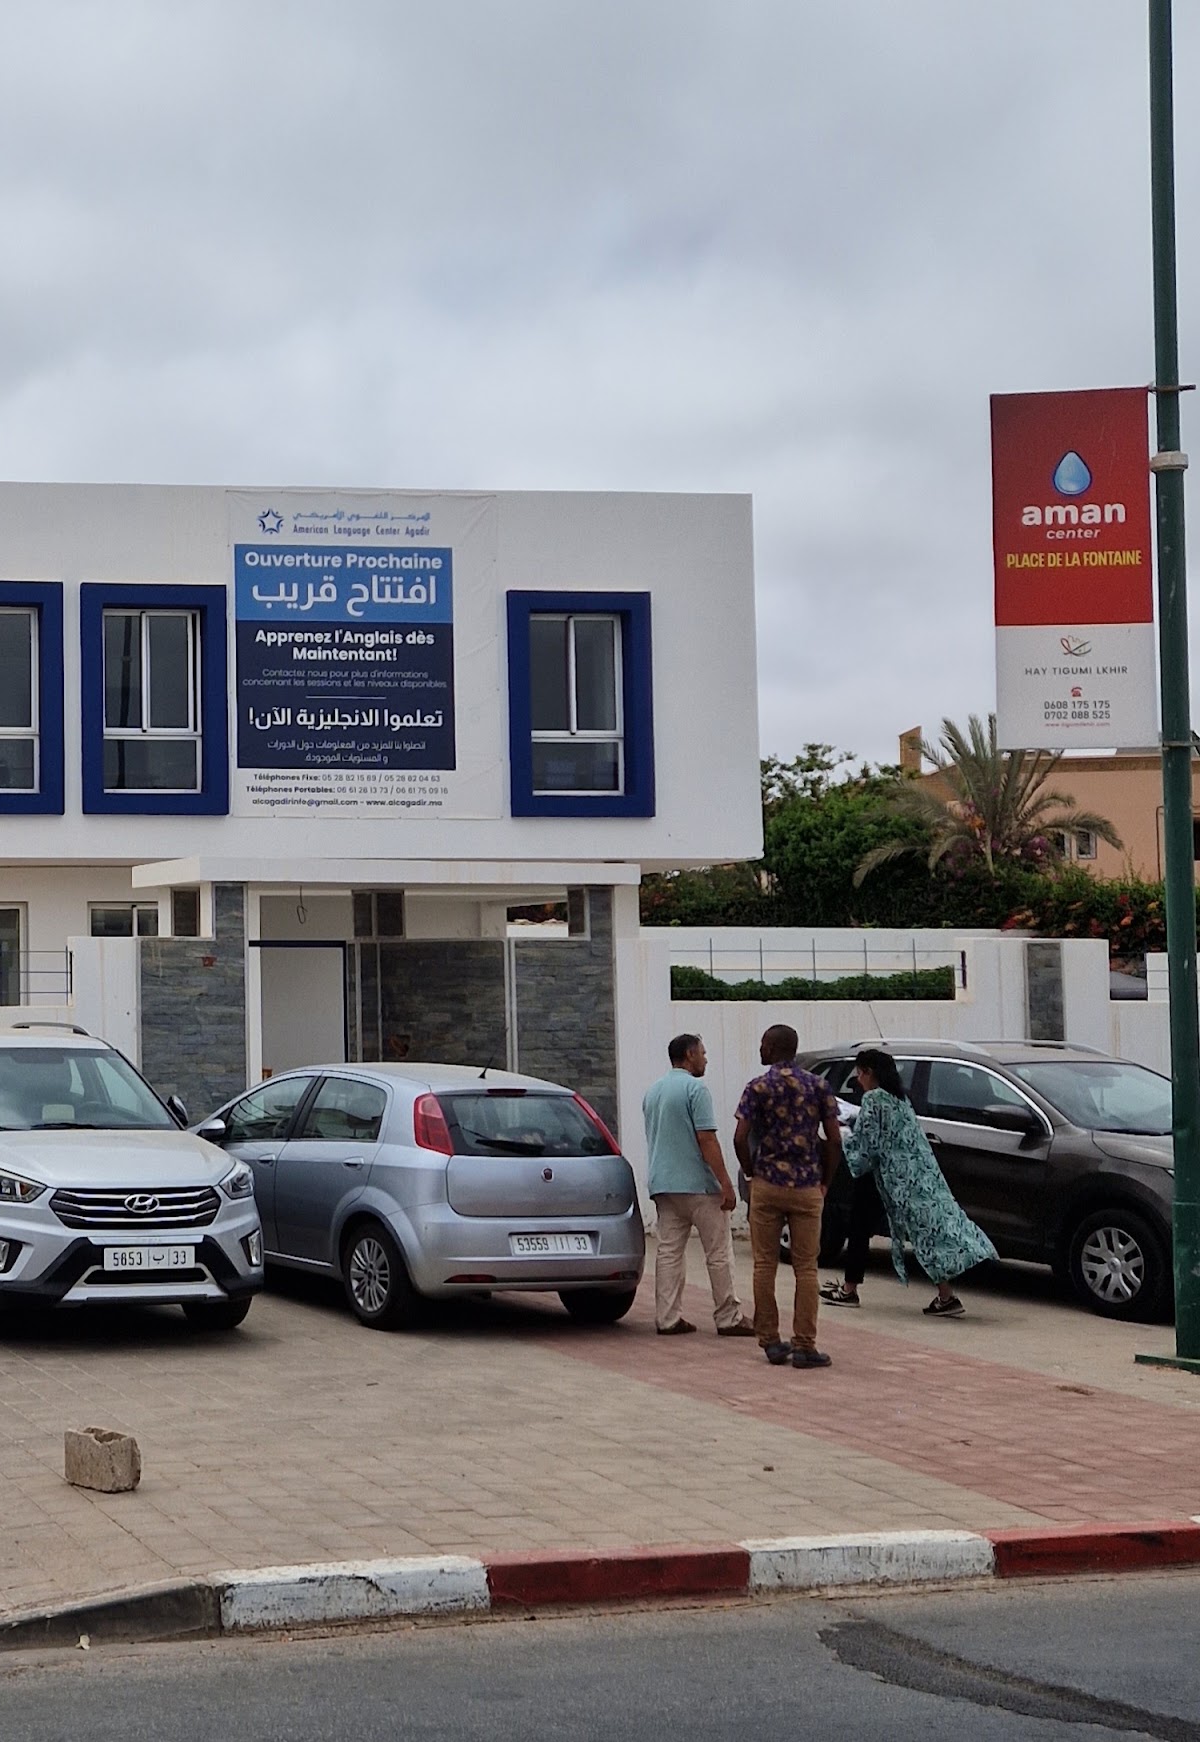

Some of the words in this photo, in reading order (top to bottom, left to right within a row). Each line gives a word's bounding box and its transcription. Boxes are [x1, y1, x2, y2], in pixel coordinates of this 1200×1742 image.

[1021, 502, 1126, 526] aman
[293, 524, 329, 535] American
[333, 525, 371, 537] Language
[375, 525, 400, 536] Center
[405, 526, 430, 538] Agadir
[1046, 528, 1101, 539] center
[244, 551, 342, 568] Ouverture
[346, 552, 443, 570] Prochaine
[1006, 552, 1045, 568] PLACE
[1047, 552, 1062, 567] DE
[1065, 551, 1080, 566] LA
[1083, 549, 1142, 566] FONTAINE
[252, 575, 337, 611] قريب
[346, 574, 436, 617] افتتاح
[255, 629, 332, 647] Apprenez
[334, 629, 403, 648] l'Anglais
[405, 630, 435, 645] dès
[293, 647, 397, 662] Maintentant!
[262, 668, 305, 677] Contactez
[307, 670, 328, 678] nous
[330, 670, 349, 679] pour
[351, 669, 368, 680] plus
[370, 669, 428, 679] d'informations
[1025, 667, 1047, 675] HAY
[1052, 667, 1092, 675] TIGUMI
[1096, 666, 1128, 674] LKHIR
[242, 678, 291, 686] concernant
[293, 678, 305, 686] les
[307, 679, 342, 687] sessions
[354, 679, 365, 687] les
[367, 680, 399, 688] niveaux
[1044, 701, 1068, 709] 0608
[1071, 701, 1089, 709] 175
[1093, 700, 1110, 708] 175
[249, 706, 291, 730] الآن!
[296, 707, 379, 730] الانجليزية
[384, 709, 443, 731] تعلموا
[1044, 711, 1068, 719] 0702
[1071, 711, 1089, 719] 088
[1092, 710, 1110, 719] 525
[254, 773, 300, 782] Téléphones
[302, 773, 320, 781] Fixe:
[246, 785, 292, 794] Téléphones
[517, 1237, 549, 1251] 53559
[574, 1237, 588, 1250] 33
[153, 1254, 164, 1264] ب
[173, 1251, 186, 1265] 33
